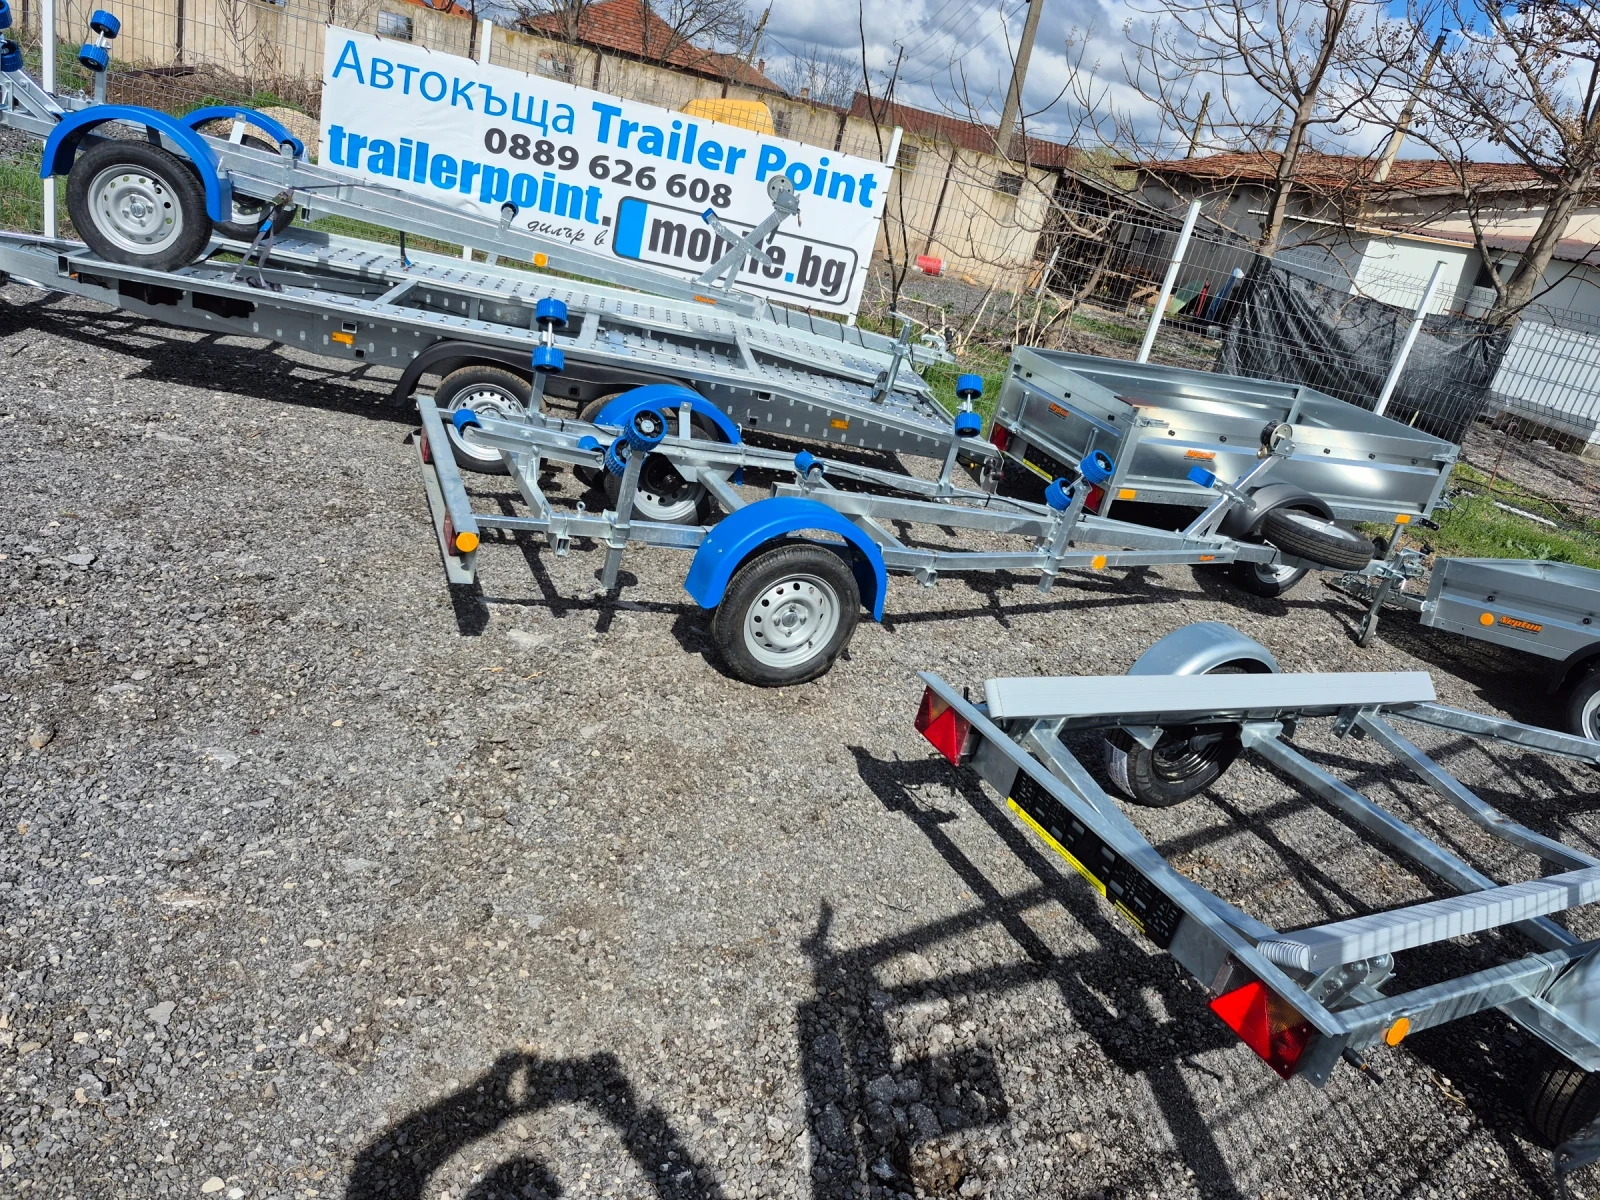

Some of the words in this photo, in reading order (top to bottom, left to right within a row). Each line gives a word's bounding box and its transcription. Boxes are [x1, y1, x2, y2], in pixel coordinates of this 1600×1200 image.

[332, 39, 576, 137] Автокъща
[592, 101, 747, 175] Trailer
[755, 144, 878, 208] Point
[484, 127, 580, 171] 0889
[588, 154, 657, 192] 626
[666, 174, 732, 209] 608
[648, 218, 847, 297] moe.bg
[1499, 616, 1543, 633] Neptun
